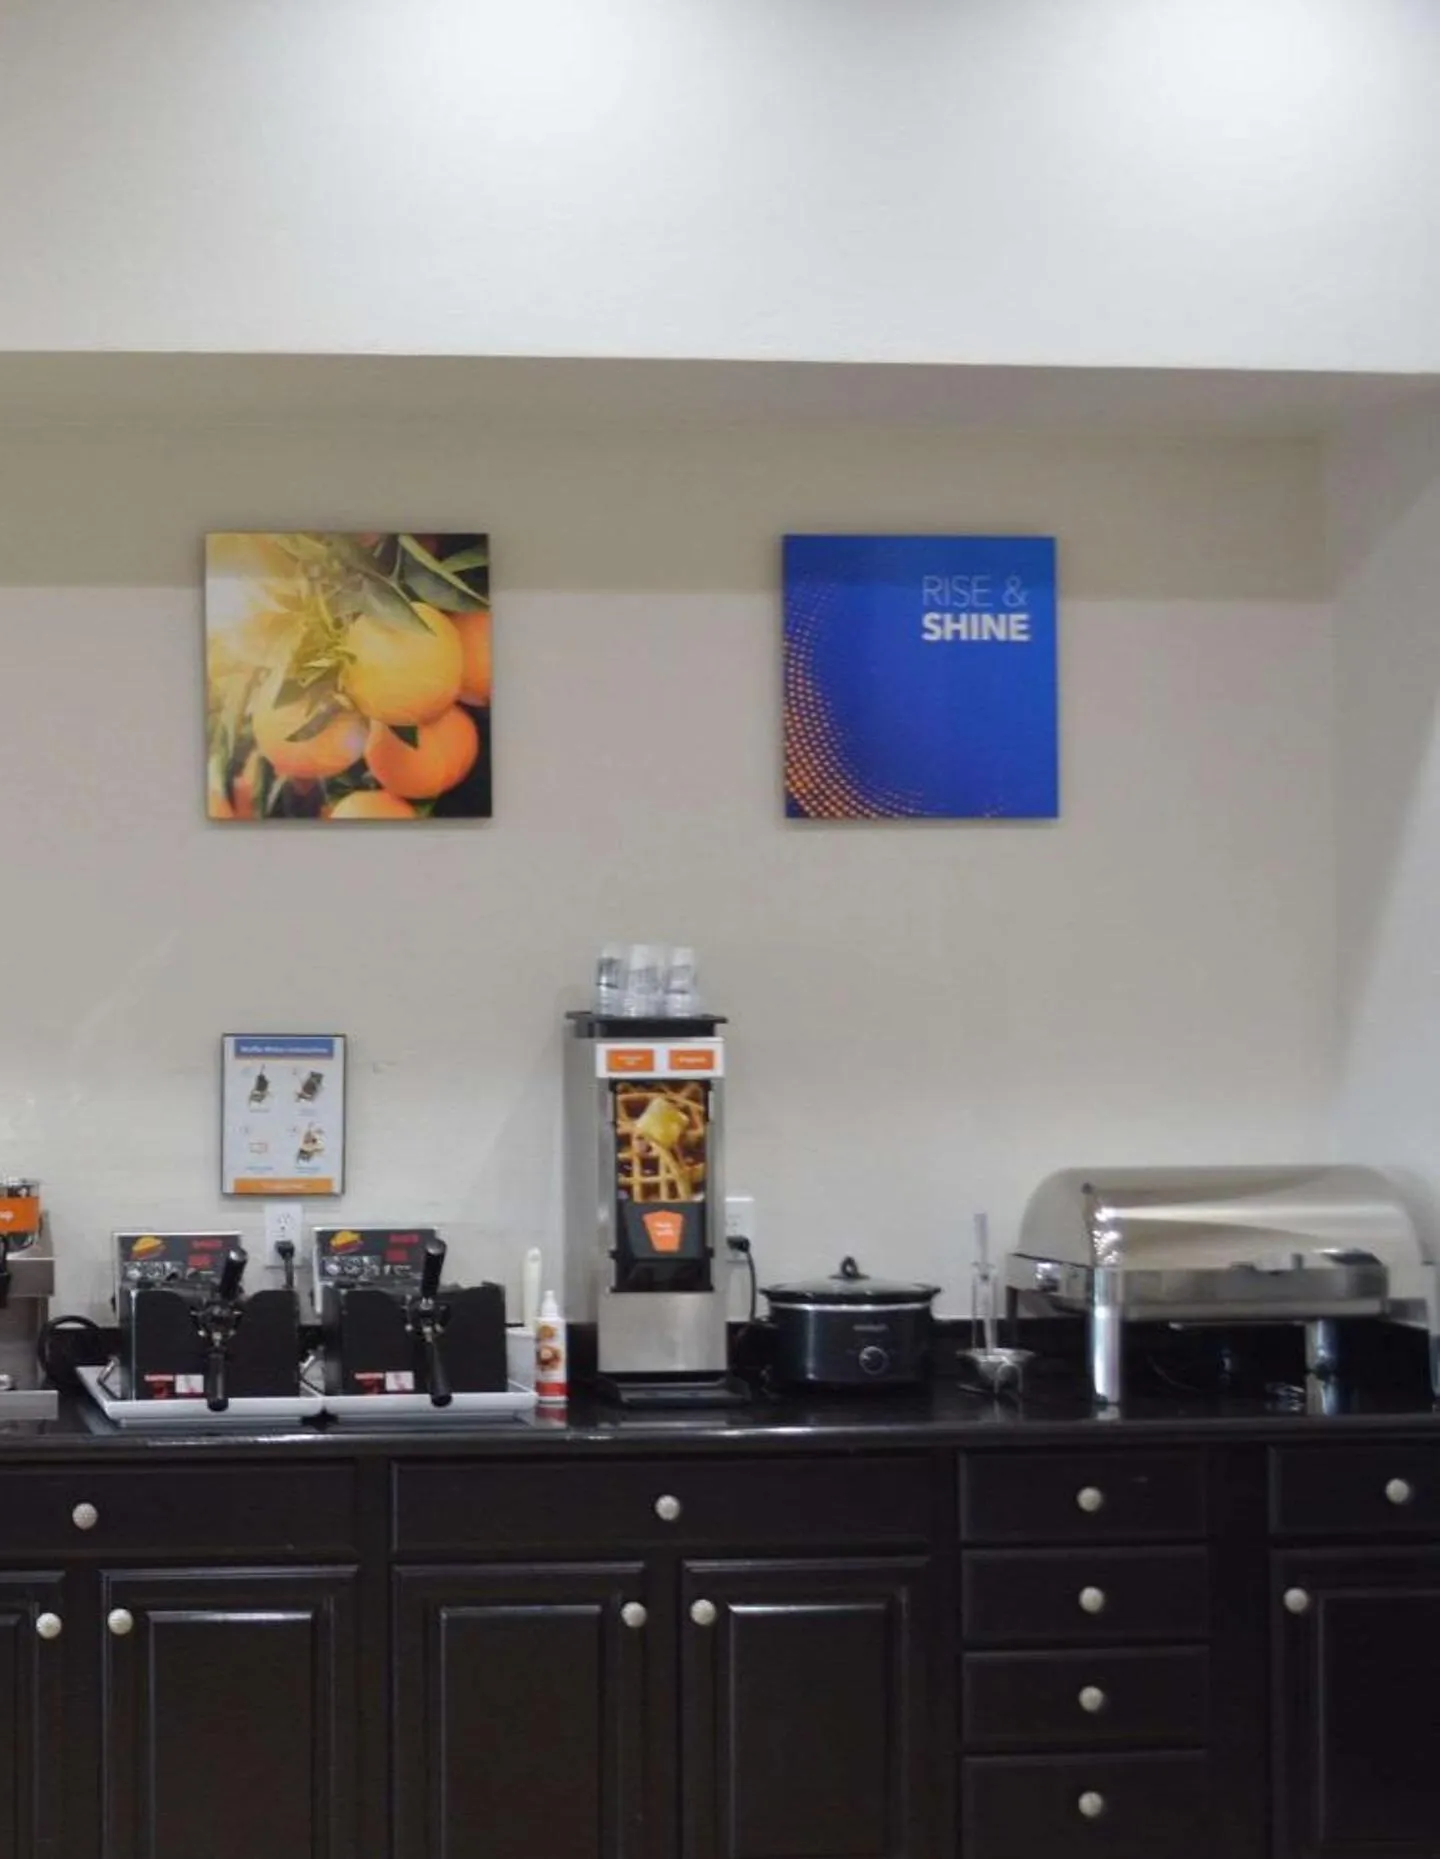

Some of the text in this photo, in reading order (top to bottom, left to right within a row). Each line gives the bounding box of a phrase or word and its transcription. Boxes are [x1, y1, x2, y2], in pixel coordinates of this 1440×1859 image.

[922, 574, 1029, 608] RISE &
[921, 612, 1031, 641] SHINE
